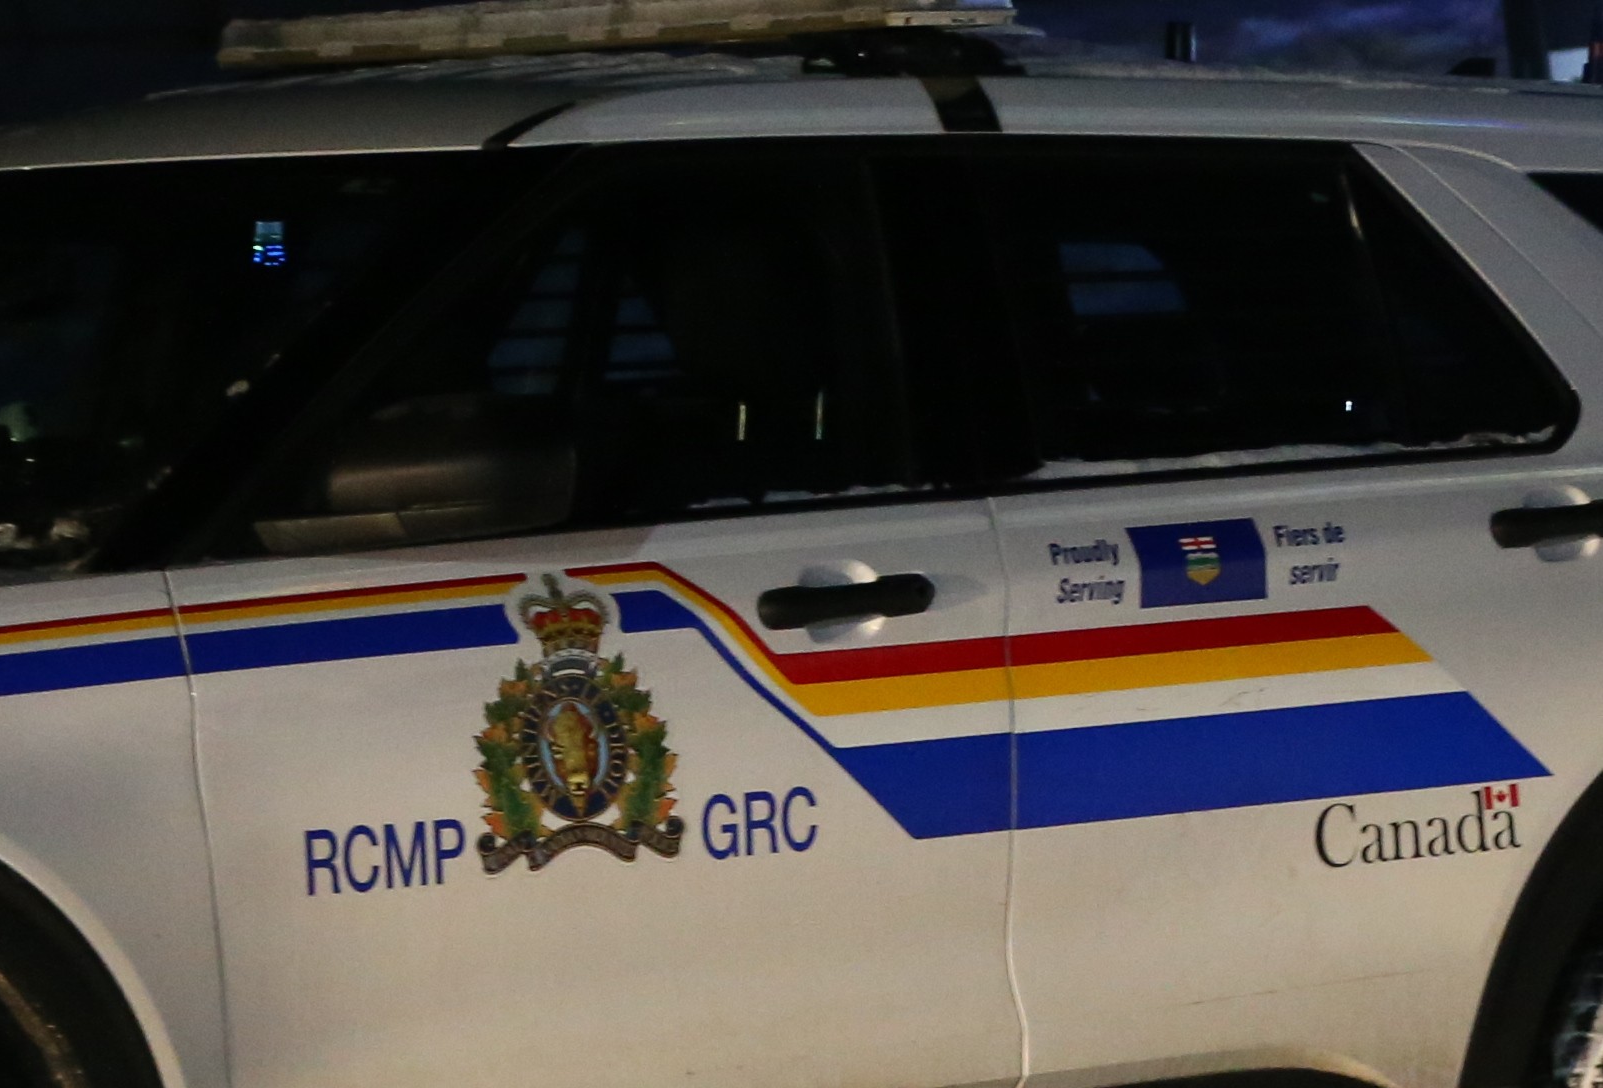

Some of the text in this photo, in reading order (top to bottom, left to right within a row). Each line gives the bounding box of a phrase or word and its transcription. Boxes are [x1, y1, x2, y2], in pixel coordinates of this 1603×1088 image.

[1272, 522, 1345, 548] Fiers de
[1048, 539, 1119, 566] Proudly
[1289, 557, 1340, 585] servir
[1056, 575, 1125, 604] Serving
[702, 786, 818, 860] GRC
[1315, 790, 1522, 868] Canada
[304, 818, 465, 895] RCMP
